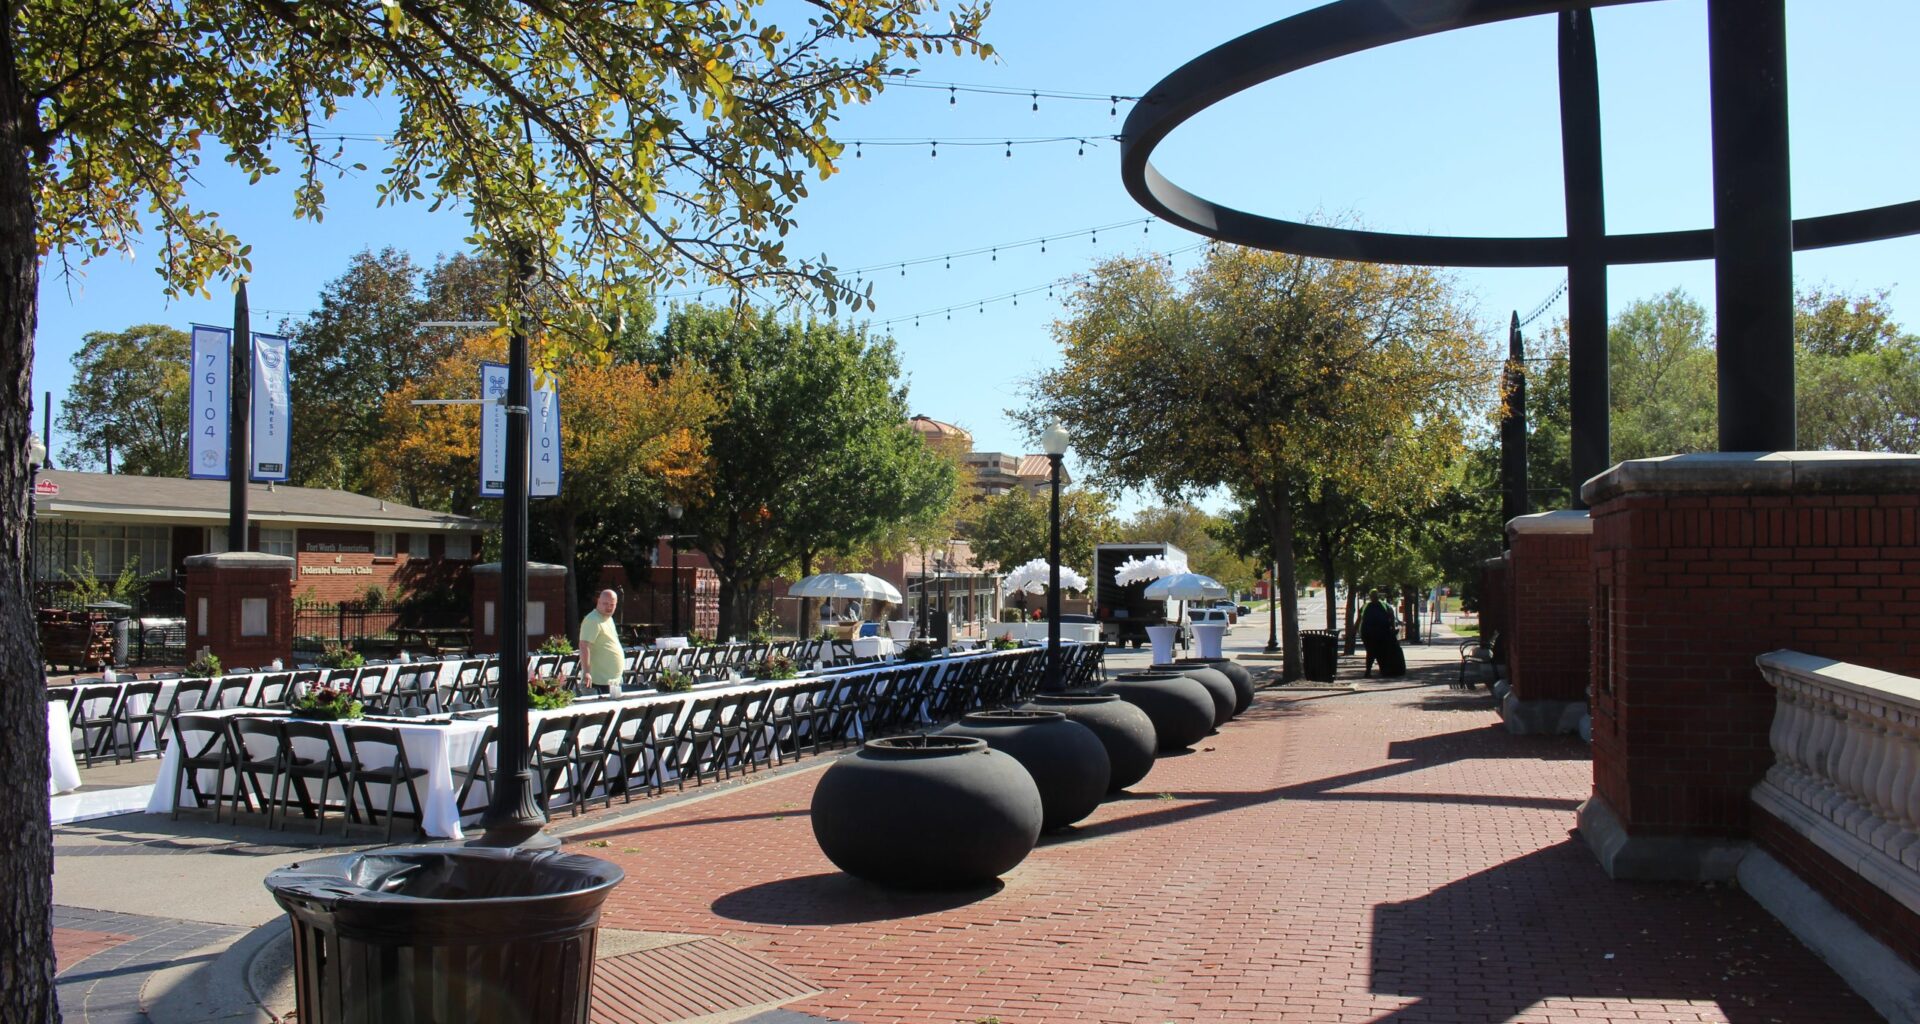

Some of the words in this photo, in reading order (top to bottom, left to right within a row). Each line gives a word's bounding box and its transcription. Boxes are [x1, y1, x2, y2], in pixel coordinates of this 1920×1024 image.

[204, 355, 216, 438] 76104
[541, 392, 550, 464] 76104
[306, 543, 318, 552] Fort
[319, 543, 336, 552] Worth
[335, 554, 342, 563] of
[302, 566, 331, 574] Federated
